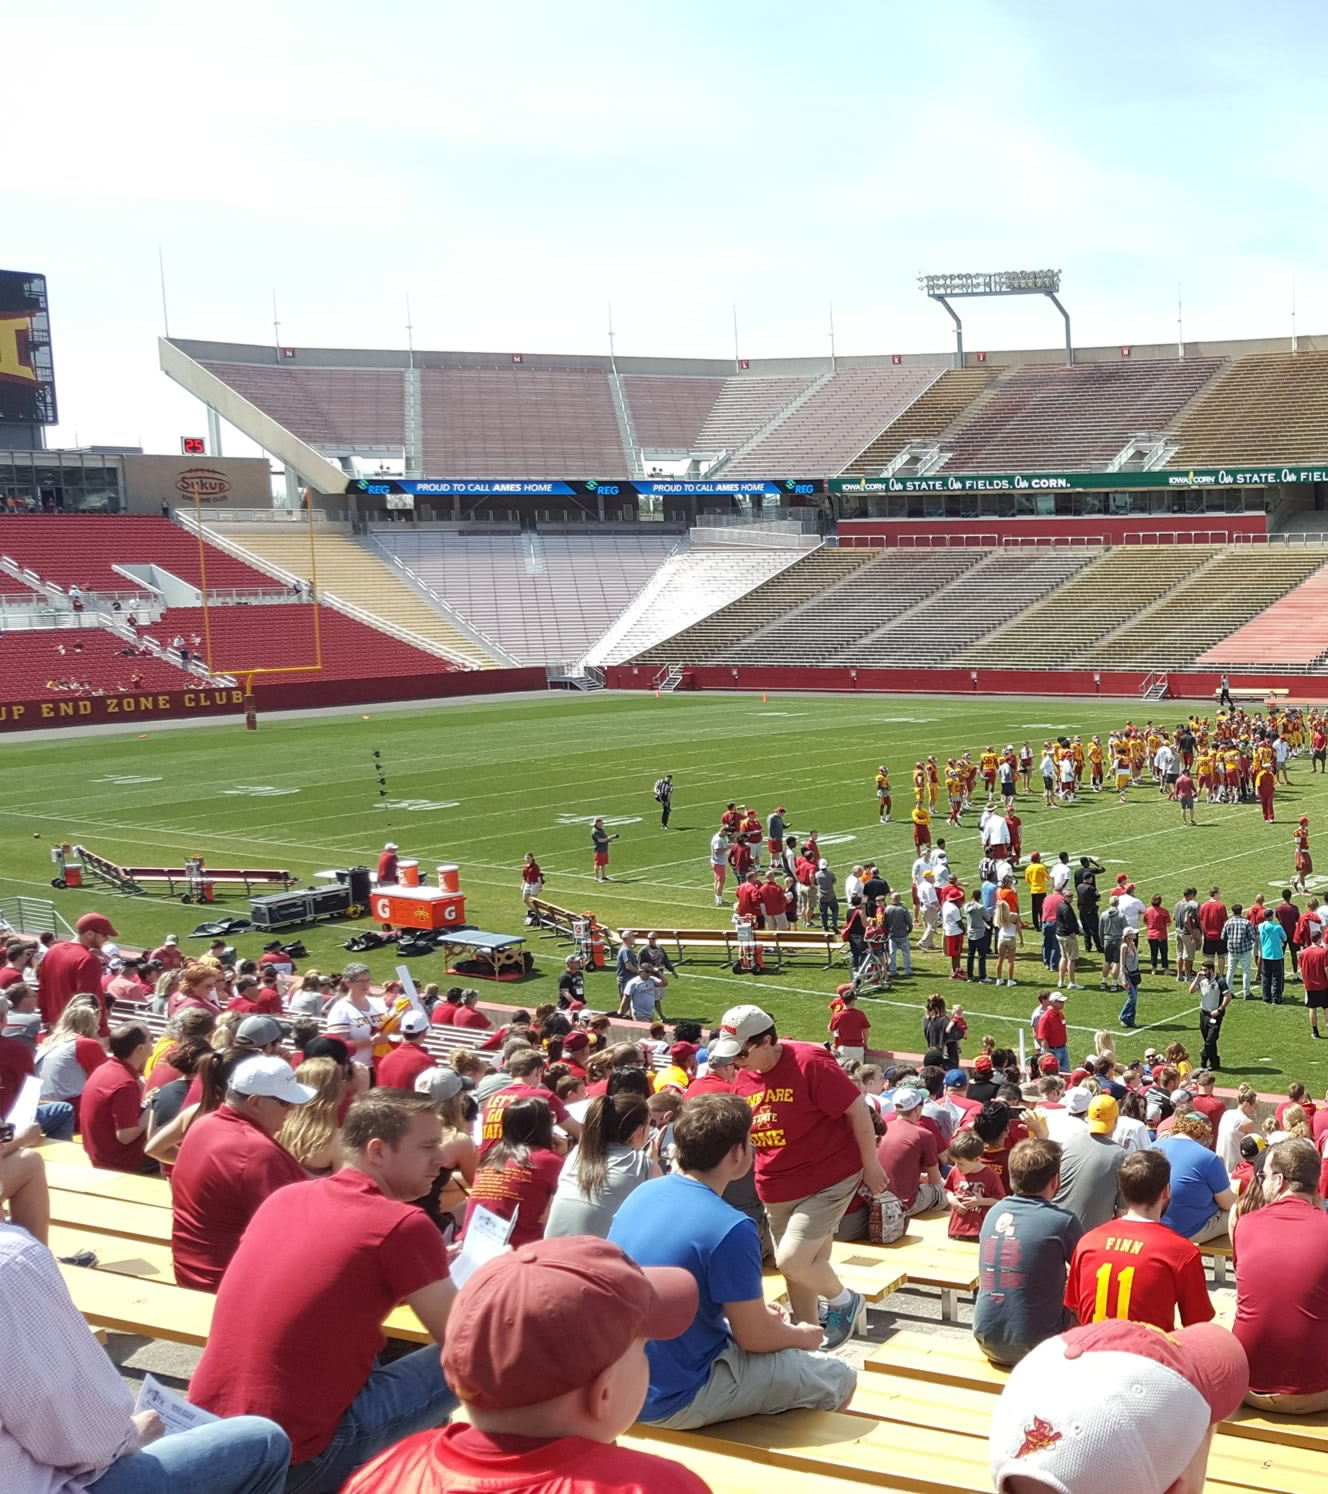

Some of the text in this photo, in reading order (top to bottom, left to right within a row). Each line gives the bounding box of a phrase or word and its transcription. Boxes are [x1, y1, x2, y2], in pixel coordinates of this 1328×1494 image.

[185, 439, 204, 453] 25
[865, 483, 886, 491] CORN
[906, 481, 947, 491] STATE.
[965, 480, 1013, 490] FIELDS.
[1031, 479, 1071, 488] CORN.
[1193, 476, 1215, 484] CORN
[1236, 473, 1280, 483] STATE.
[367, 485, 390, 494] REG
[416, 483, 552, 492] PROUD TO CALL AMES HOME
[597, 485, 619, 495] REG
[653, 483, 765, 492] PROUD TO CALL AMES HOME
[795, 484, 814, 494] REG
[41, 701, 92, 718] END
[107, 695, 170, 713] ZONE
[184, 690, 244, 708] CLUB
[377, 899, 391, 919] G
[444, 906, 456, 920] G
[765, 1088, 794, 1103] ARE
[751, 1129, 787, 1147] ONE
[1105, 1237, 1144, 1255] FINN
[1092, 1262, 1135, 1324] 11
